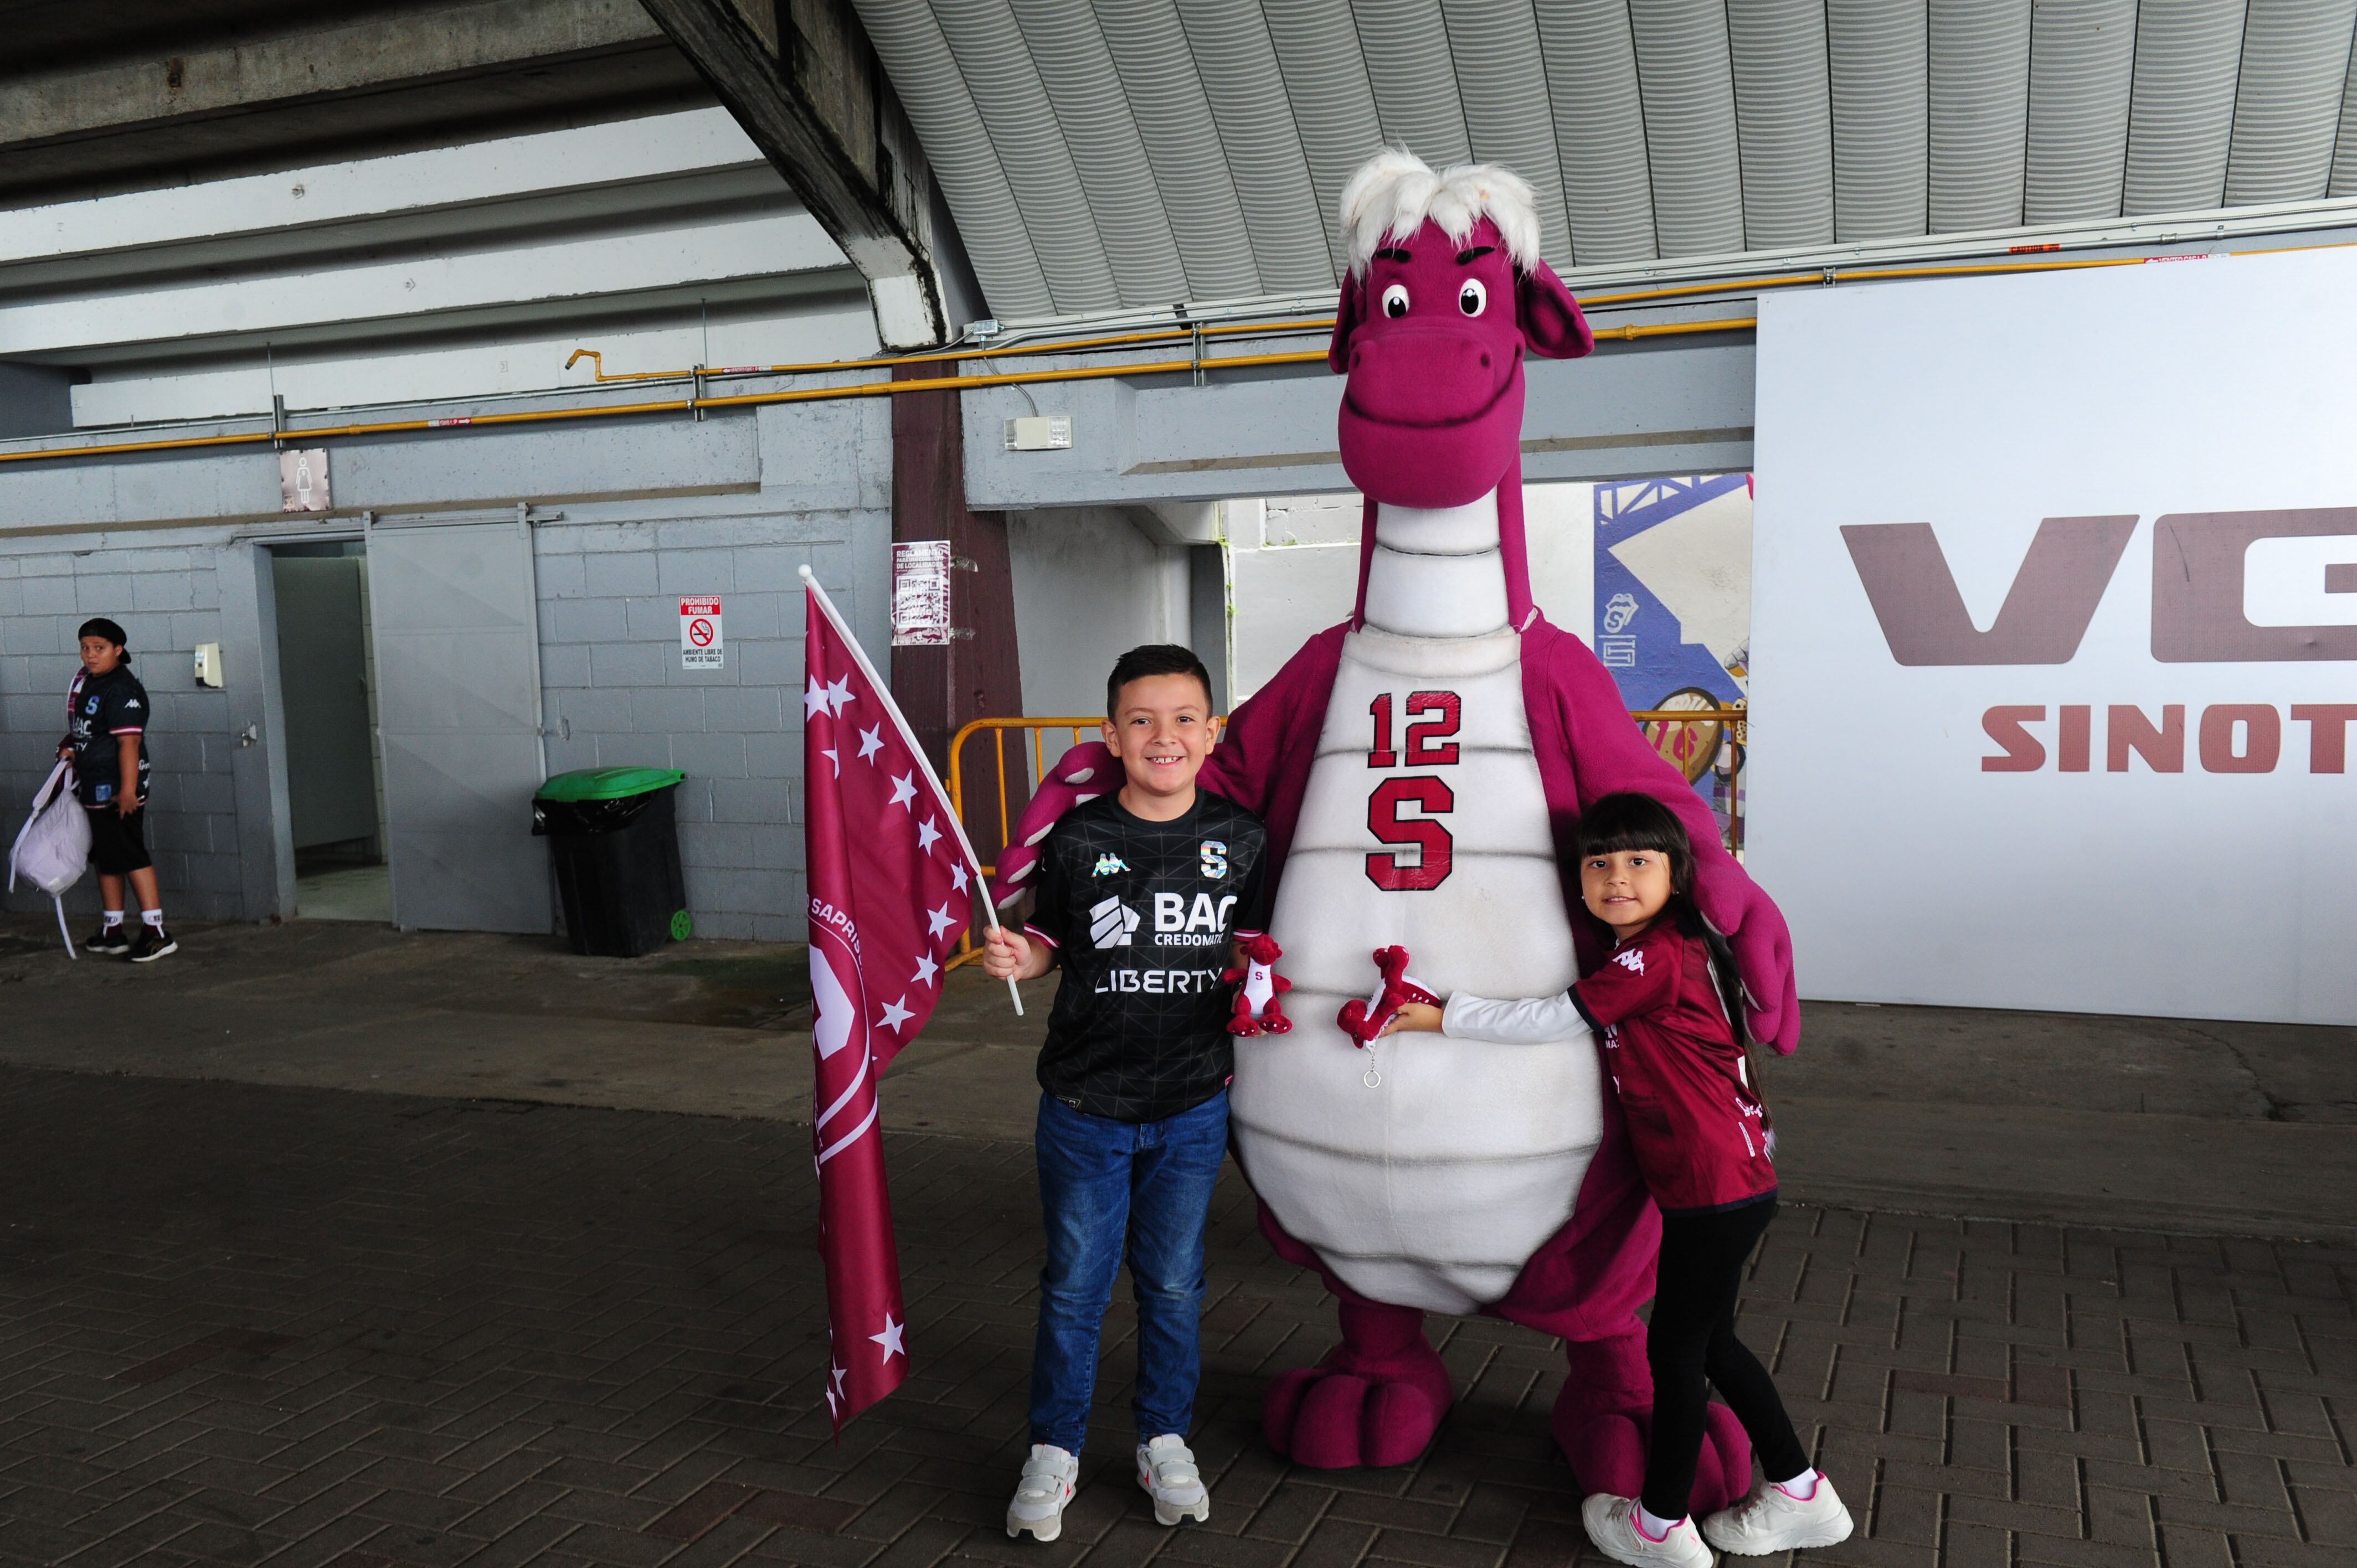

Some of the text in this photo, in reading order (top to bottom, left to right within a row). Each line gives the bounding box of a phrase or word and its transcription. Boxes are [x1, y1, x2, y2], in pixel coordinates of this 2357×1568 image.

[896, 549, 944, 558] REGLAMENTO
[681, 597, 719, 606] PROHIBIDO
[688, 606, 713, 615] FUMAR
[85, 695, 100, 715] S
[1367, 690, 1461, 768] 12
[1982, 704, 2357, 774] SINOT
[1365, 775, 1454, 891] S
[1200, 840, 1227, 879] S
[1155, 892, 1238, 933] BAC
[811, 898, 863, 972] SAPRIS
[1094, 967, 1223, 993] LIBERTY
[1255, 971, 1263, 981] S
